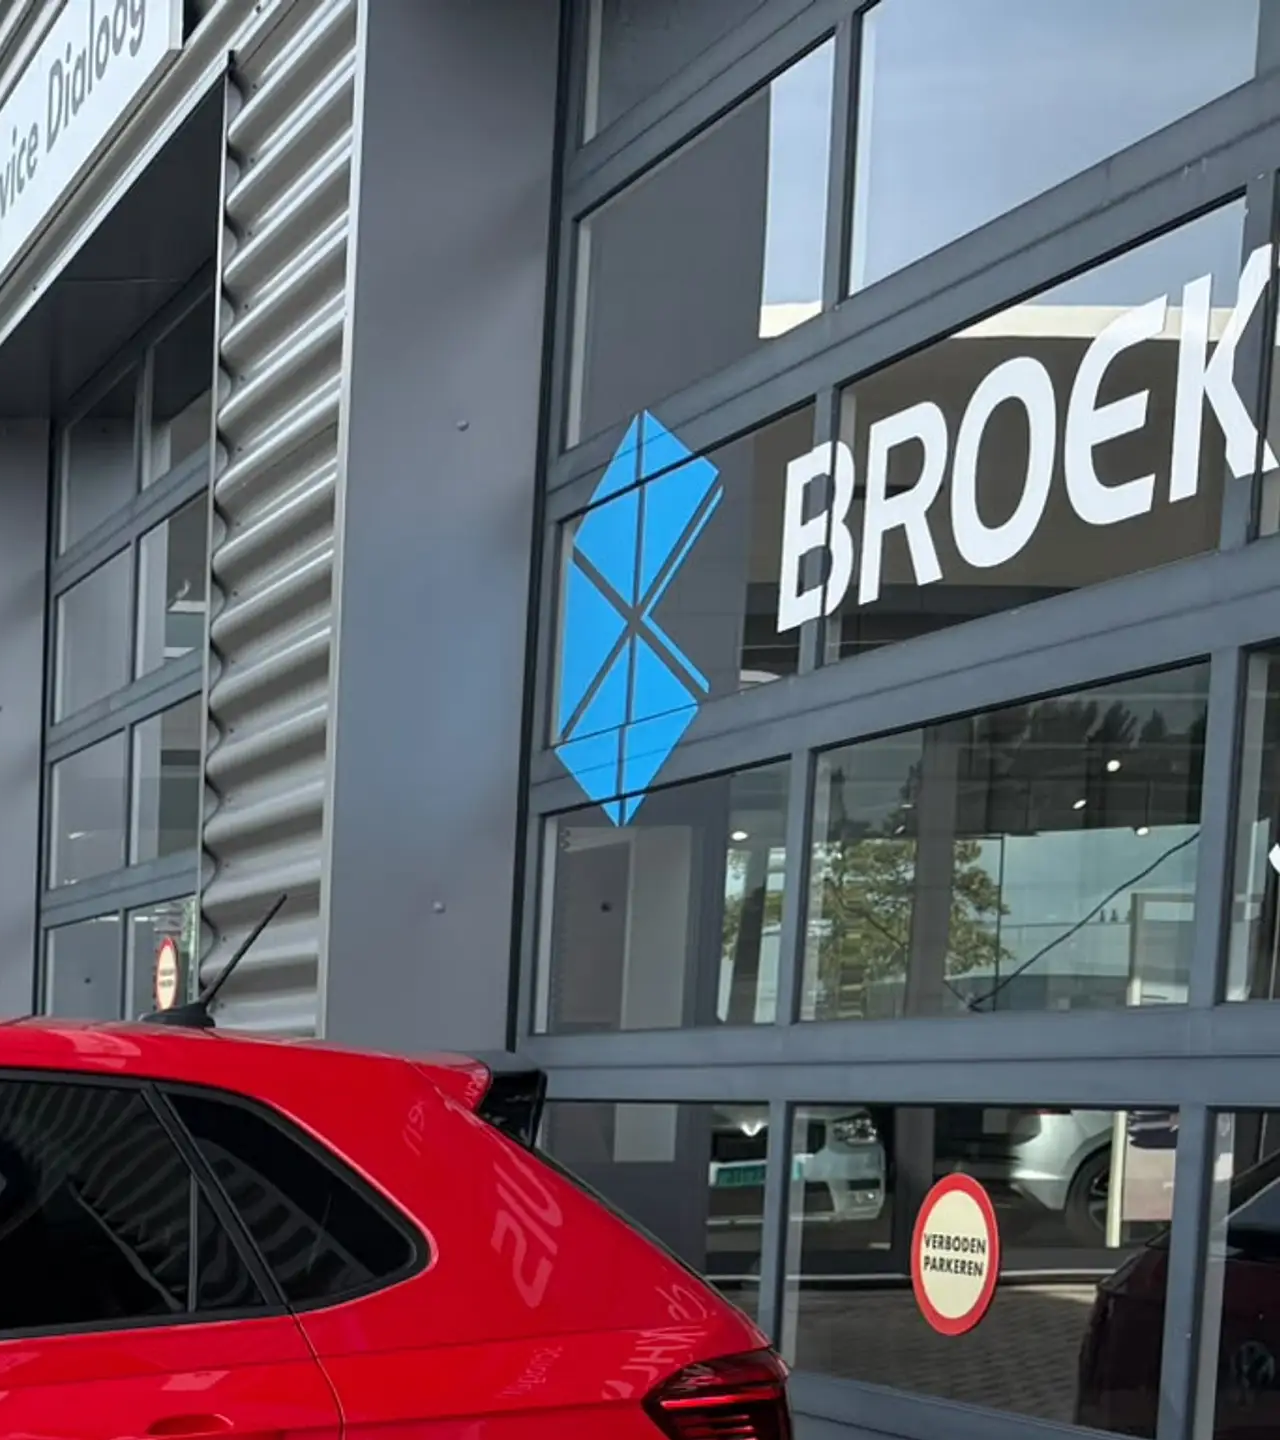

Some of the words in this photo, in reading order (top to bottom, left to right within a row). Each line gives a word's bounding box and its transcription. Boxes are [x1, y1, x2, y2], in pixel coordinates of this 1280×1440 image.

[46, 0, 146, 154] Dialoog
[777, 242, 1280, 634] BROEK
[923, 1256, 984, 1277] PARKEREN
[924, 1234, 986, 1254] VERBODEN
